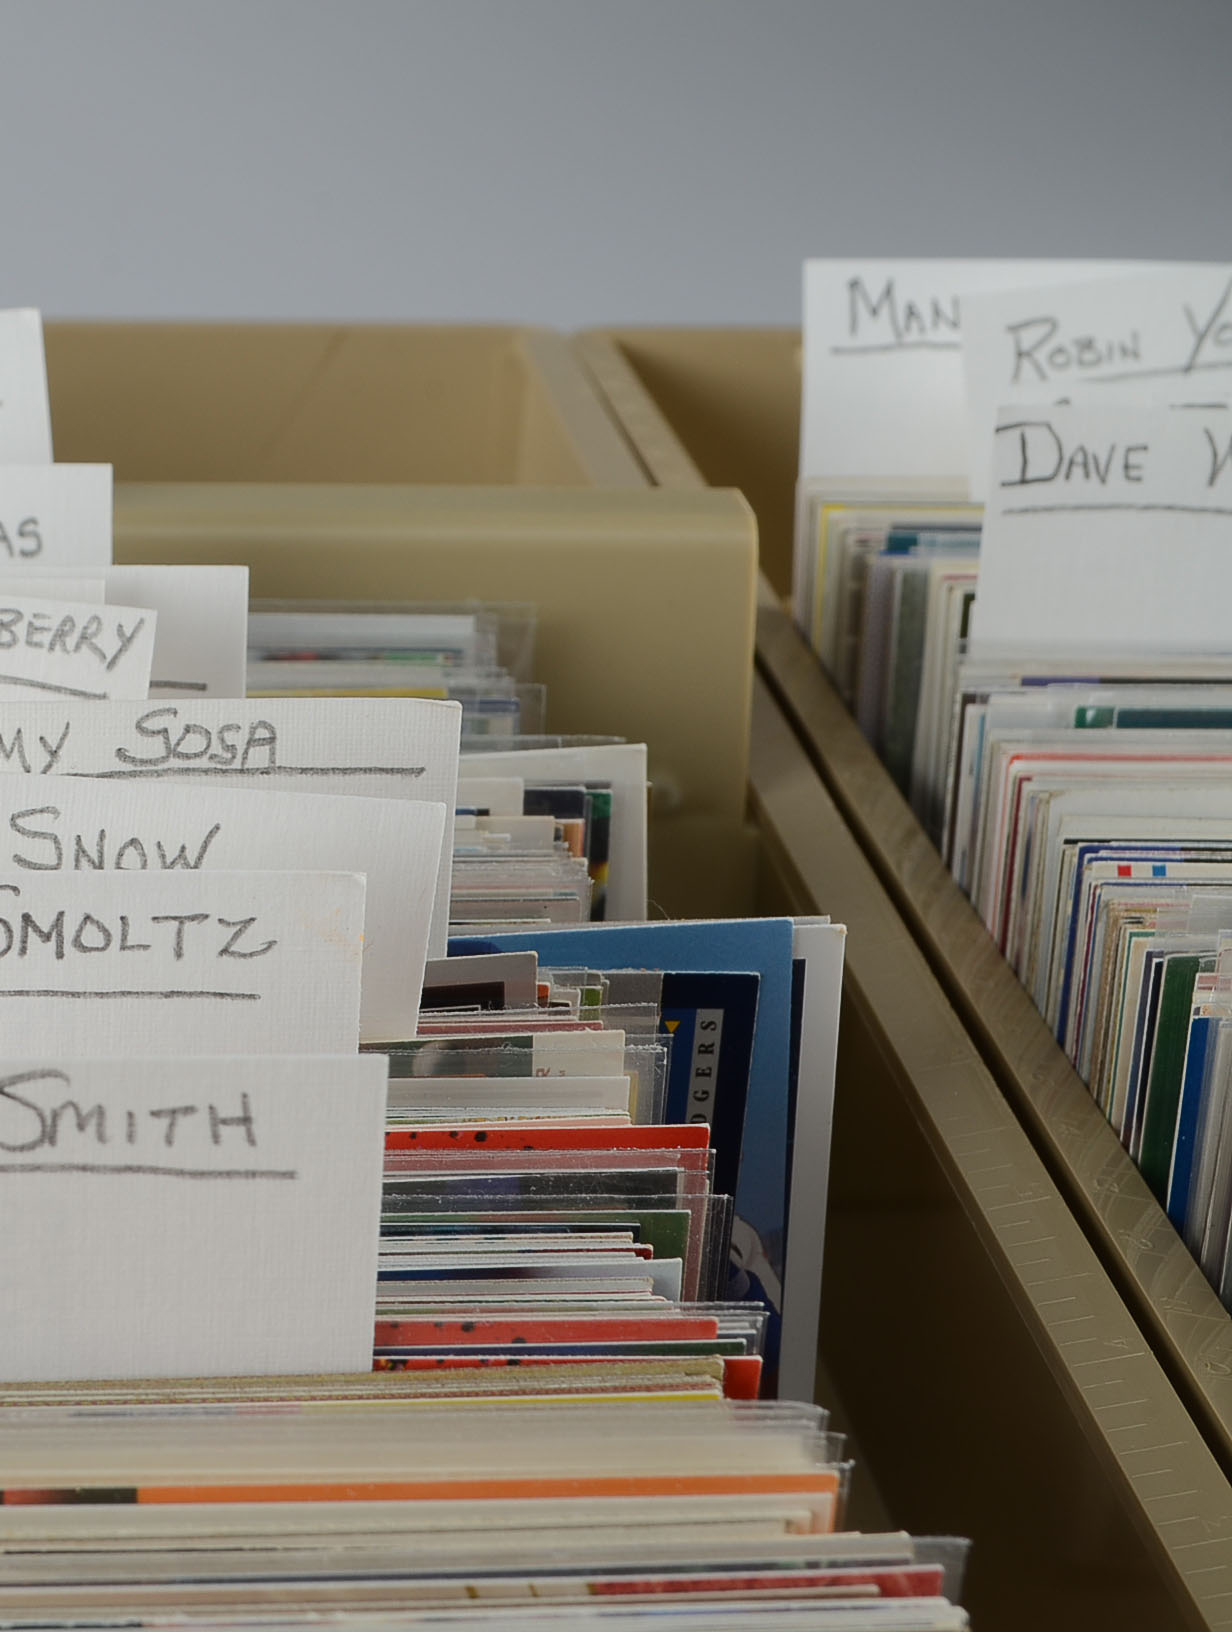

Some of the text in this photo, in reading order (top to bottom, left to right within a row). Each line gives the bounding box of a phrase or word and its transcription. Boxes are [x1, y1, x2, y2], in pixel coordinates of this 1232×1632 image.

[1006, 316, 1141, 384] ROBIN
[996, 420, 1150, 489] DAVE
[115, 707, 278, 767] SOSA
[9, 805, 221, 871] SNOW
